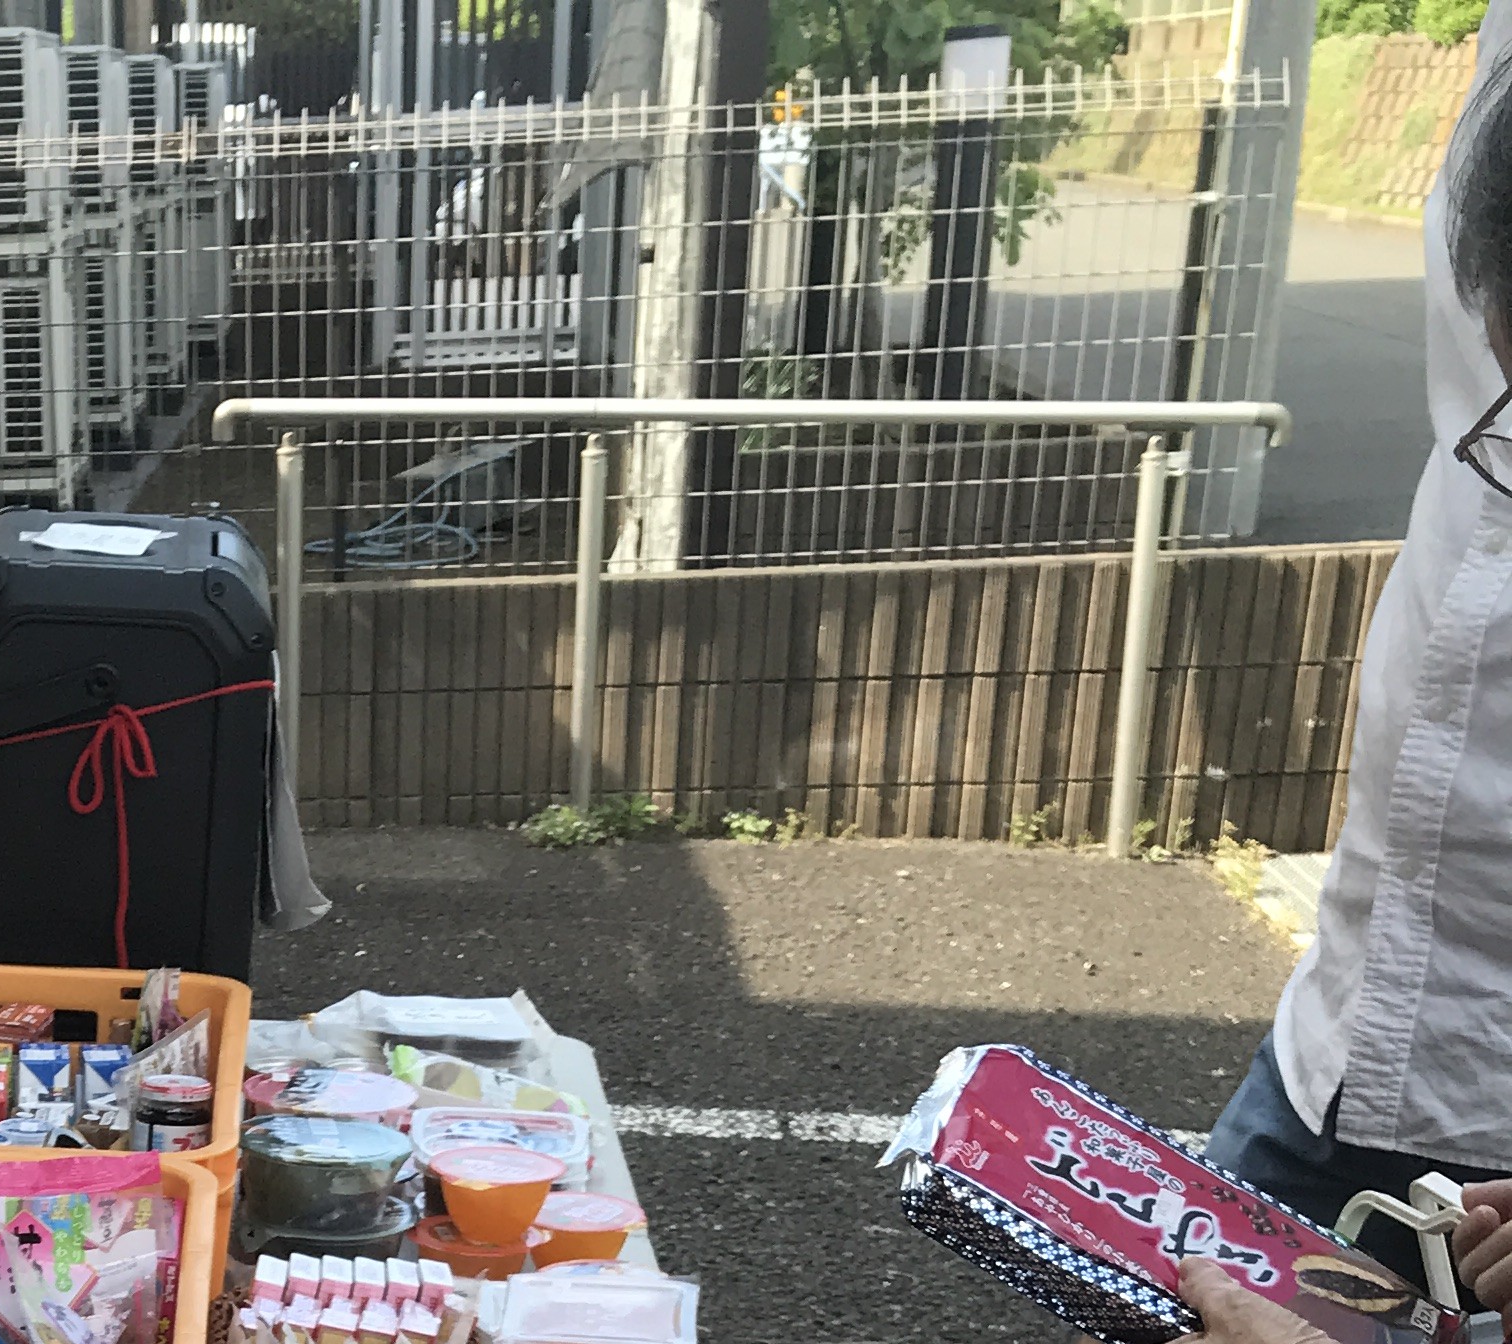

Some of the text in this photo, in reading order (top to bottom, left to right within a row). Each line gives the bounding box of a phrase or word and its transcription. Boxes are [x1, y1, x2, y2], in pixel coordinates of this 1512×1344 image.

[1082, 1136, 1186, 1194] 和菓子屋の
